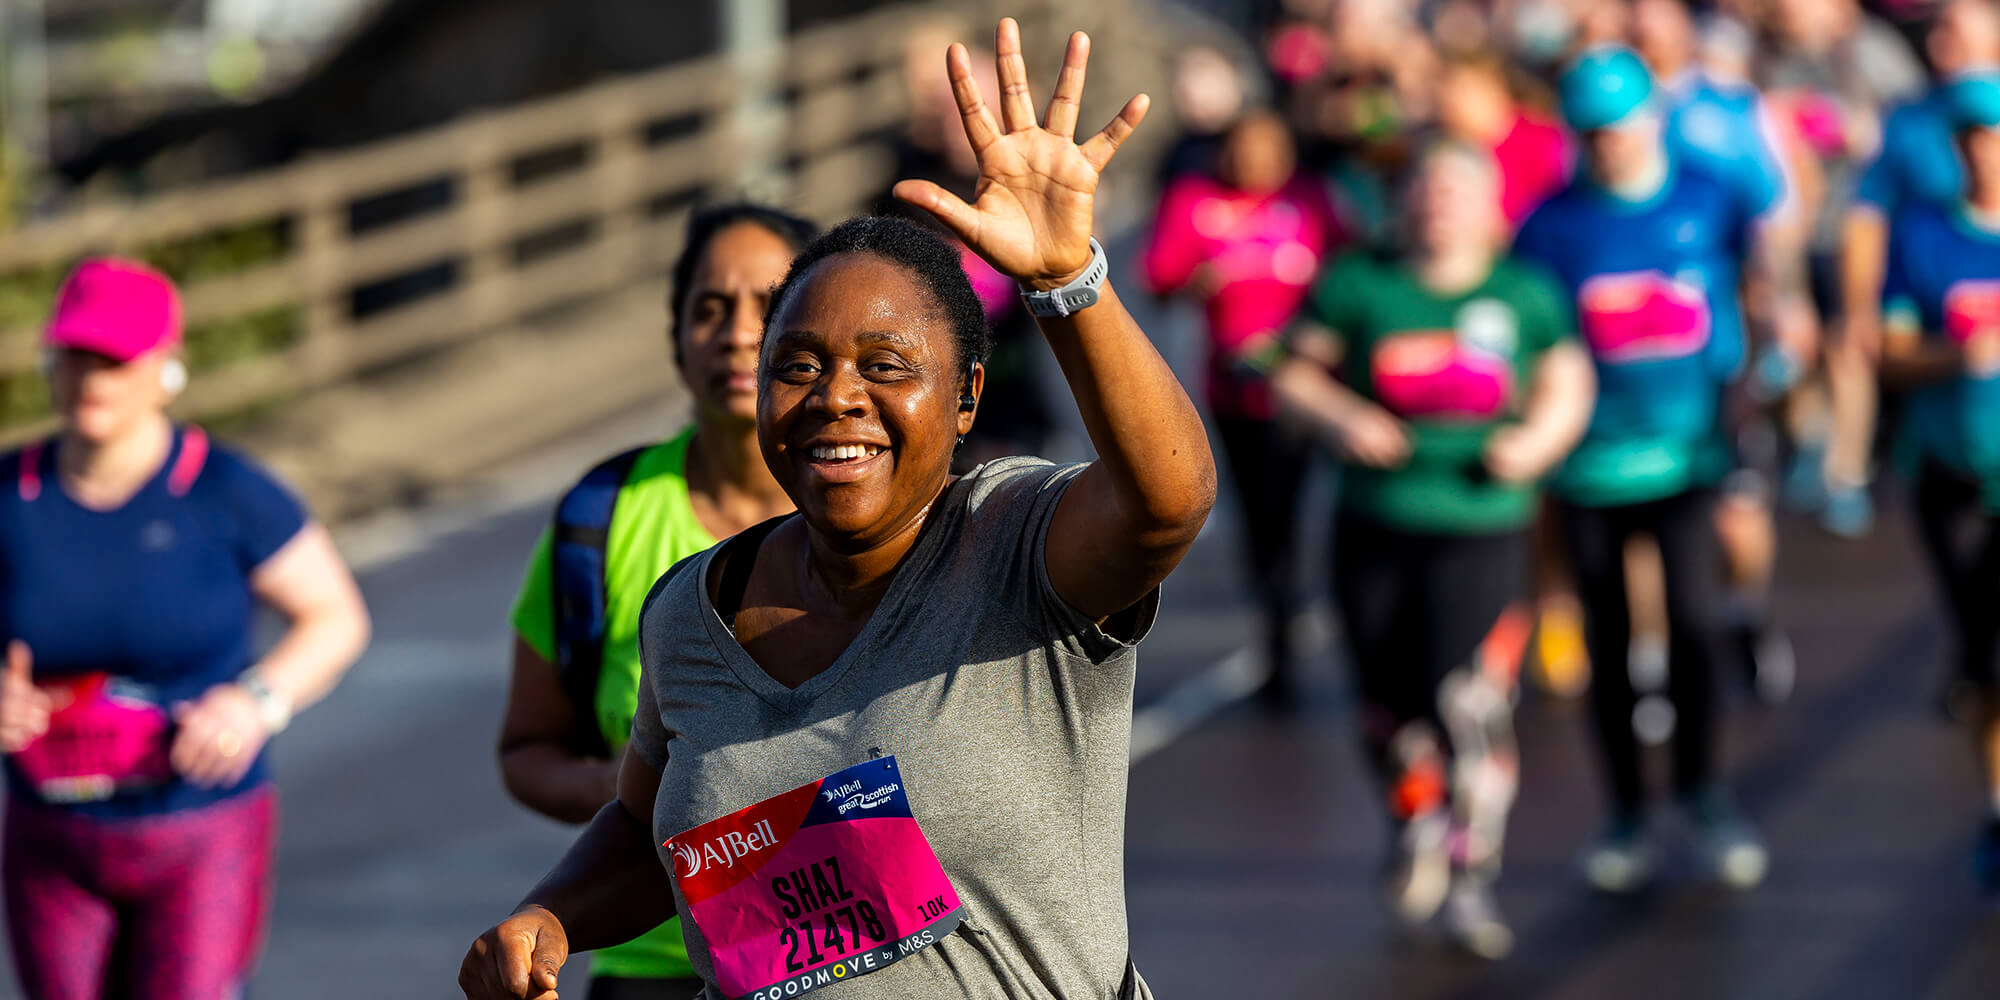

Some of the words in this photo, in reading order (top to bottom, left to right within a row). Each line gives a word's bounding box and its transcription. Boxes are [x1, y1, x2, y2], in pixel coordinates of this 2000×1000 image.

[838, 797, 859, 815] great
[864, 782, 899, 802] scottish
[878, 795, 891, 805] run
[771, 856, 853, 919] SHAZ
[917, 894, 949, 922] 10K
[780, 899, 886, 974] 21478
[753, 953, 877, 1000] GOODMOVE
[882, 951, 894, 960] by
[898, 929, 935, 956] M&S
